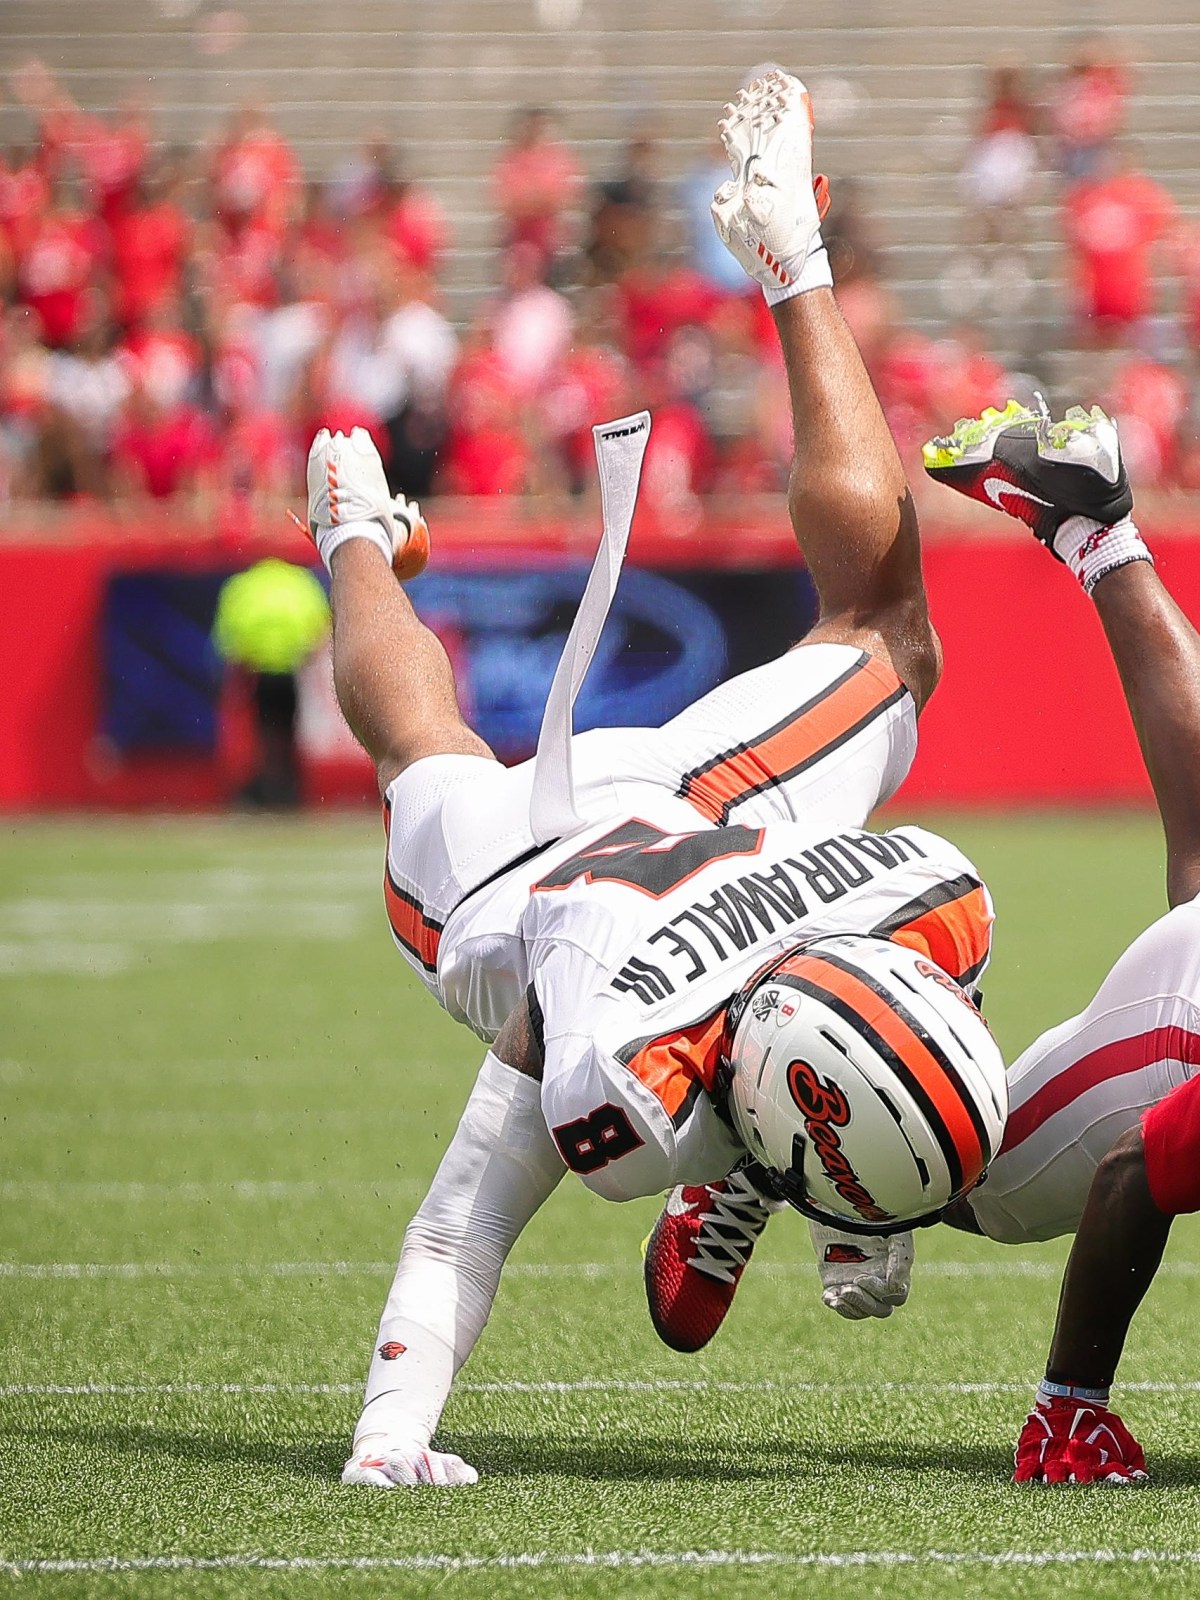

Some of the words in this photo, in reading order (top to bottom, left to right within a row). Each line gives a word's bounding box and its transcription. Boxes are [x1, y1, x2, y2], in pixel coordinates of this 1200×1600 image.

[610, 956, 676, 1006] III
[781, 1004, 794, 1017] 8
[552, 1102, 646, 1175] 8
